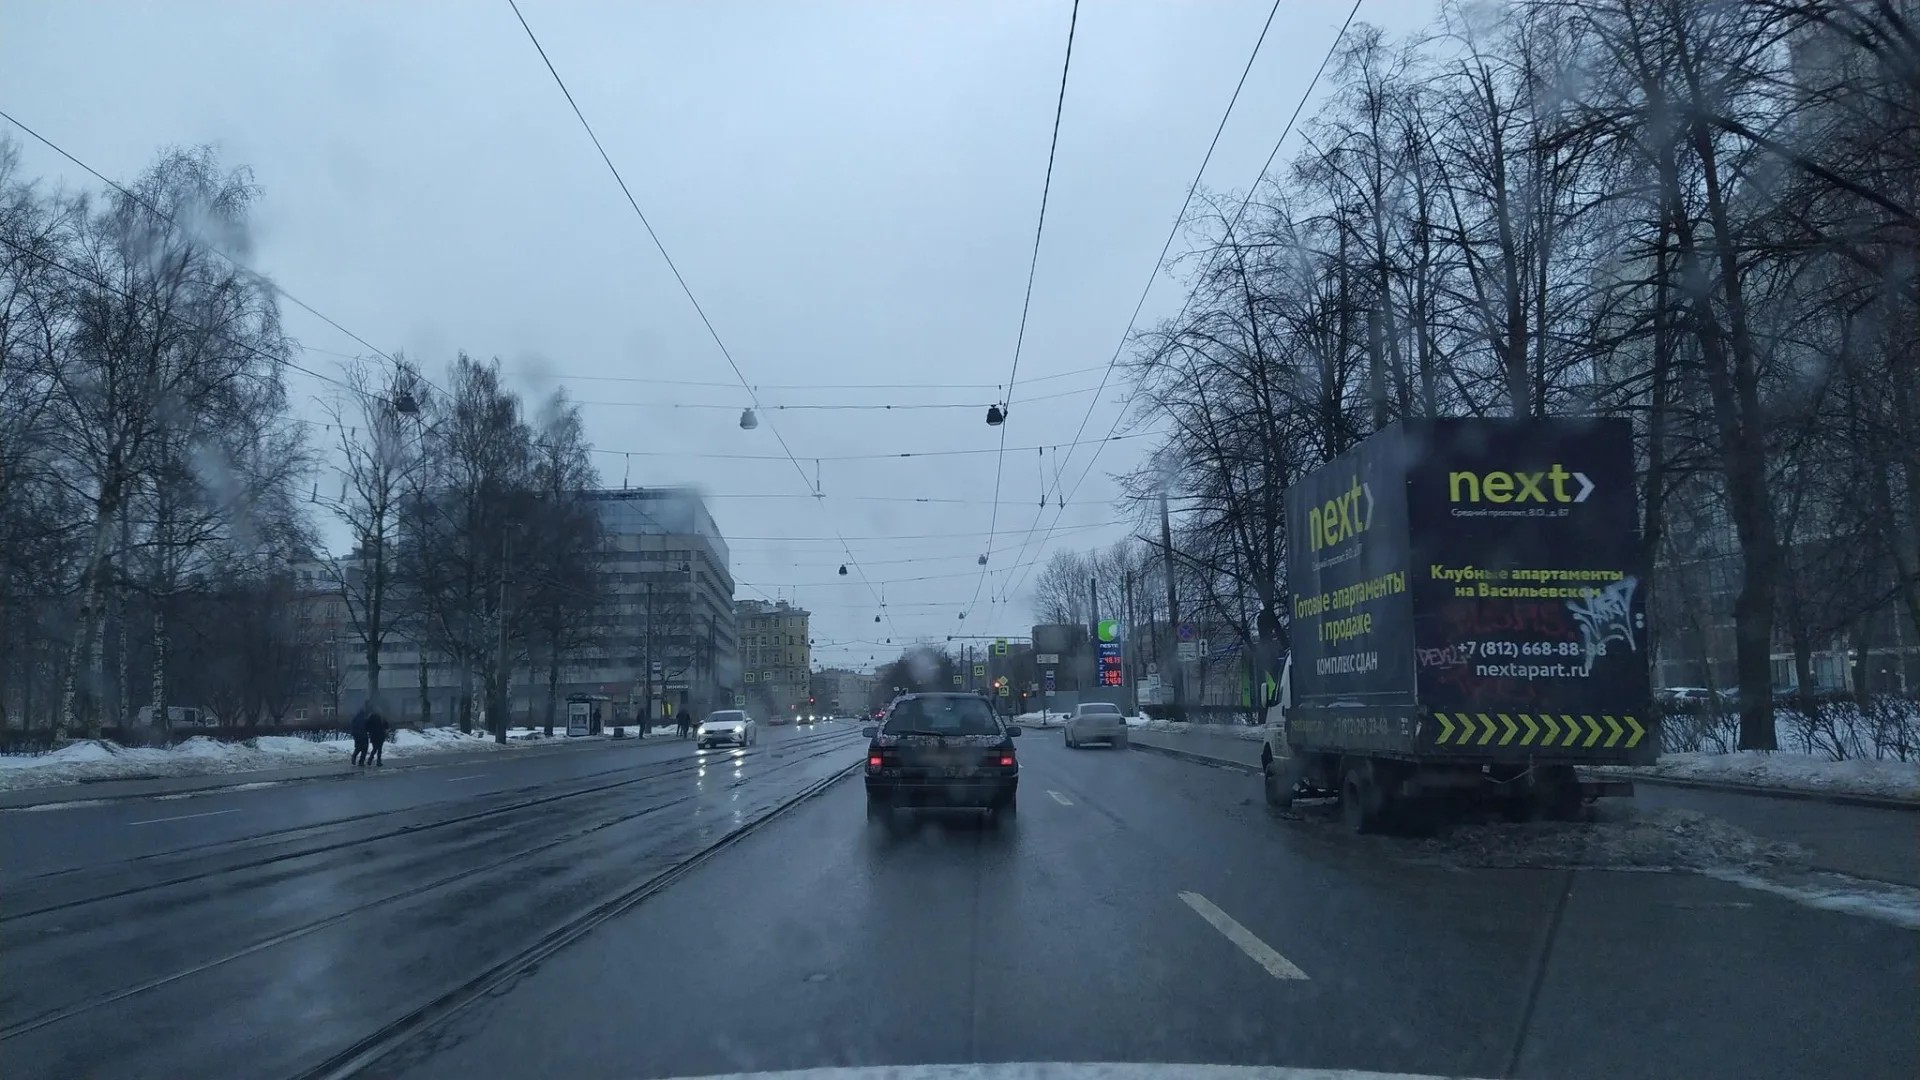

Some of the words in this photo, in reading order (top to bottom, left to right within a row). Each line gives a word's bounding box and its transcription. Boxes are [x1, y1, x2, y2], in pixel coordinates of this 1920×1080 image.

[1449, 464, 1571, 503] next
[1309, 475, 1363, 552] next
[1511, 568, 1624, 583] апартаменты
[1293, 593, 1331, 620] Готовые
[1332, 571, 1406, 613] апартаменты
[1455, 586, 1474, 597] на
[1478, 582, 1602, 599] Васильевском
[1318, 627, 1323, 641] в
[1325, 612, 1372, 646] продаже
[1457, 642, 1476, 655] +7
[1480, 642, 1519, 658] (812)
[1522, 642, 1608, 656] 668-88-88
[1316, 655, 1355, 675] КОМПЛЕКС
[1355, 652, 1378, 674] СДАН
[1476, 663, 1591, 680] nextapart.ru
